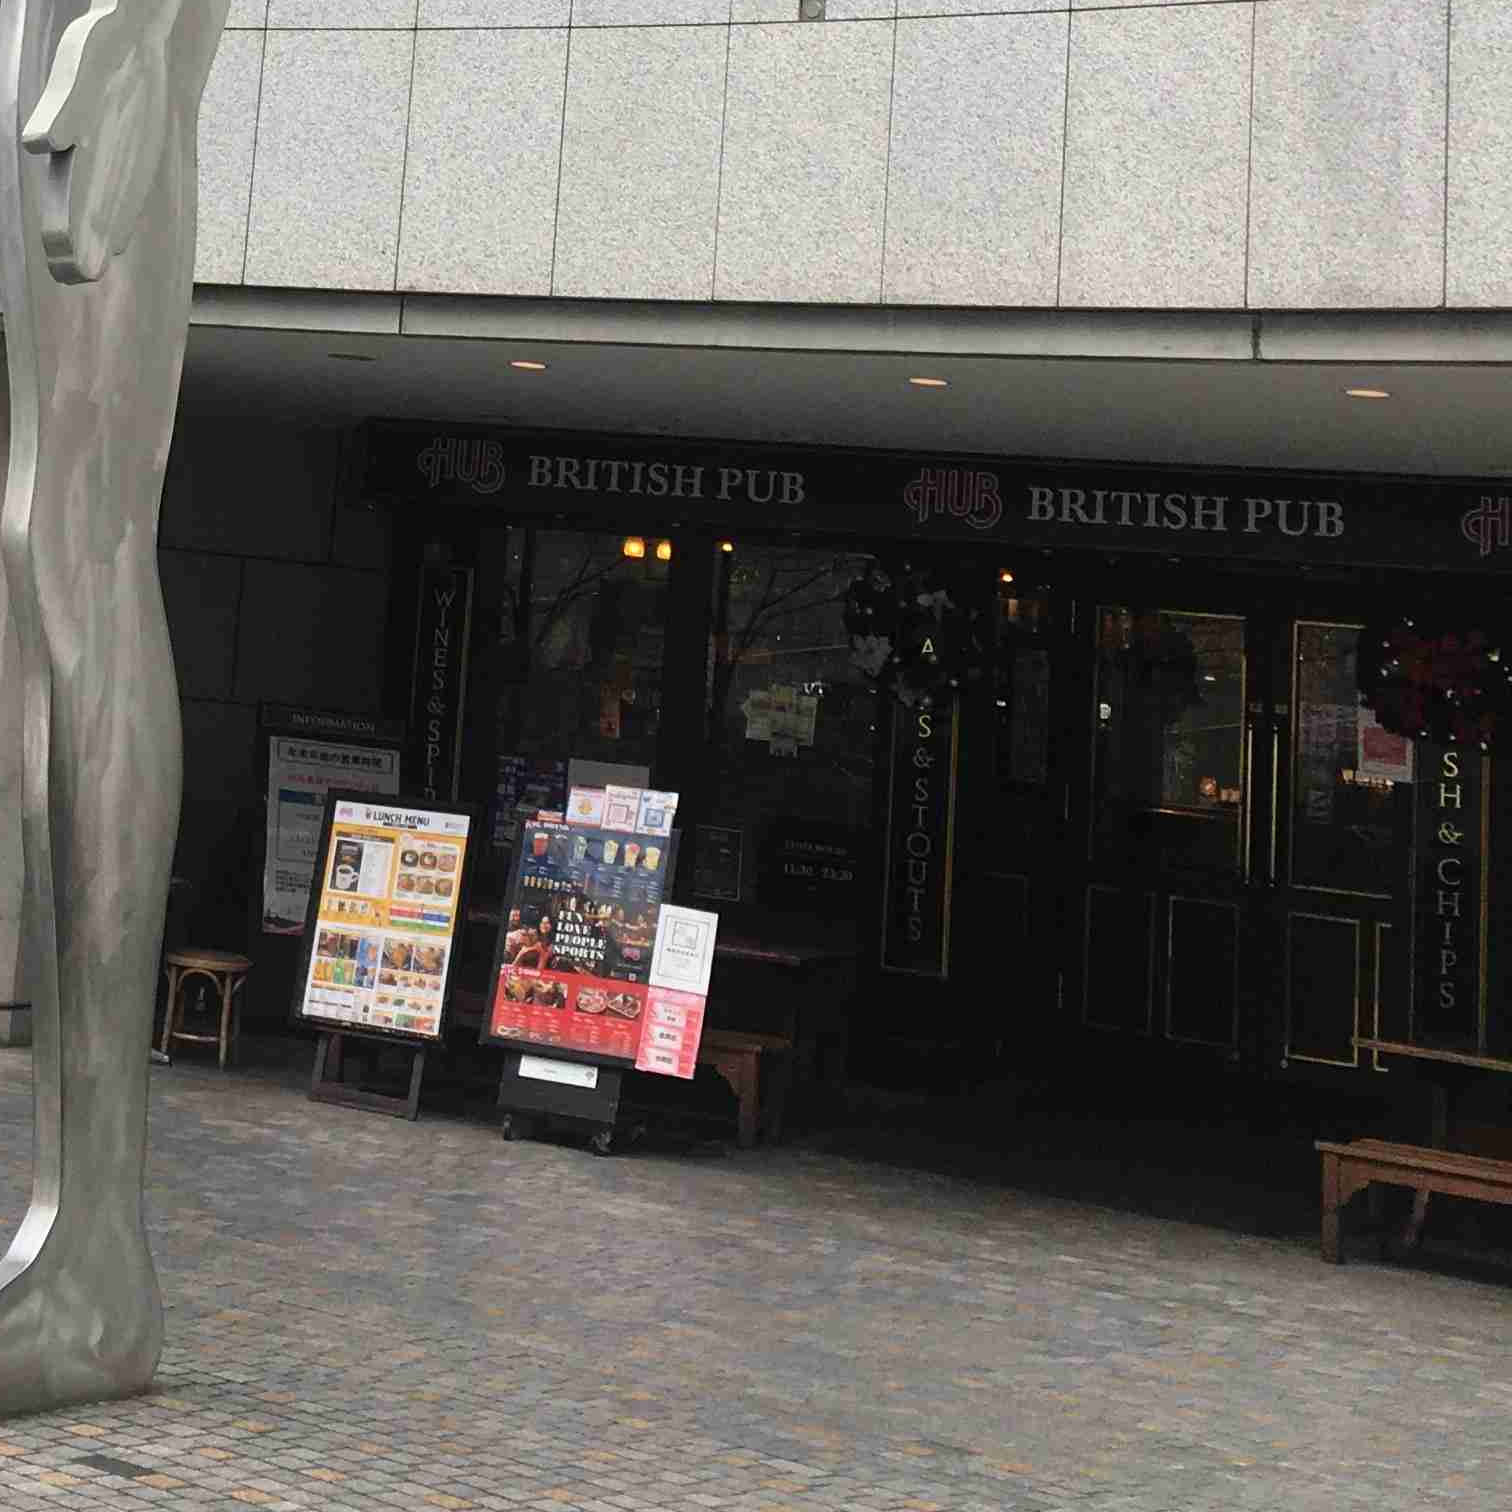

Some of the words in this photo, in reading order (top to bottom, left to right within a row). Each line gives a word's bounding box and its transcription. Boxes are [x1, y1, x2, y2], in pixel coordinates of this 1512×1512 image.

[416, 433, 505, 495] HUB
[528, 455, 705, 498] BRITISH
[714, 466, 808, 504] PUB
[903, 468, 1003, 530] HUB
[1027, 486, 1229, 533] BRITISH
[1242, 496, 1346, 538] PUB
[1461, 495, 1512, 559] H
[432, 584, 456, 691] WINES
[427, 695, 447, 714] &
[913, 745, 936, 768] &
[373, 810, 403, 824] LUNCH
[404, 814, 430, 826] MENU
[1438, 822, 1464, 845] &
[906, 776, 932, 942] STOUTS
[556, 922, 592, 935] LOVE
[1436, 857, 1463, 1008] CHIPS
[552, 944, 605, 961] SPORTS
[554, 933, 608, 950] PEOPLE
